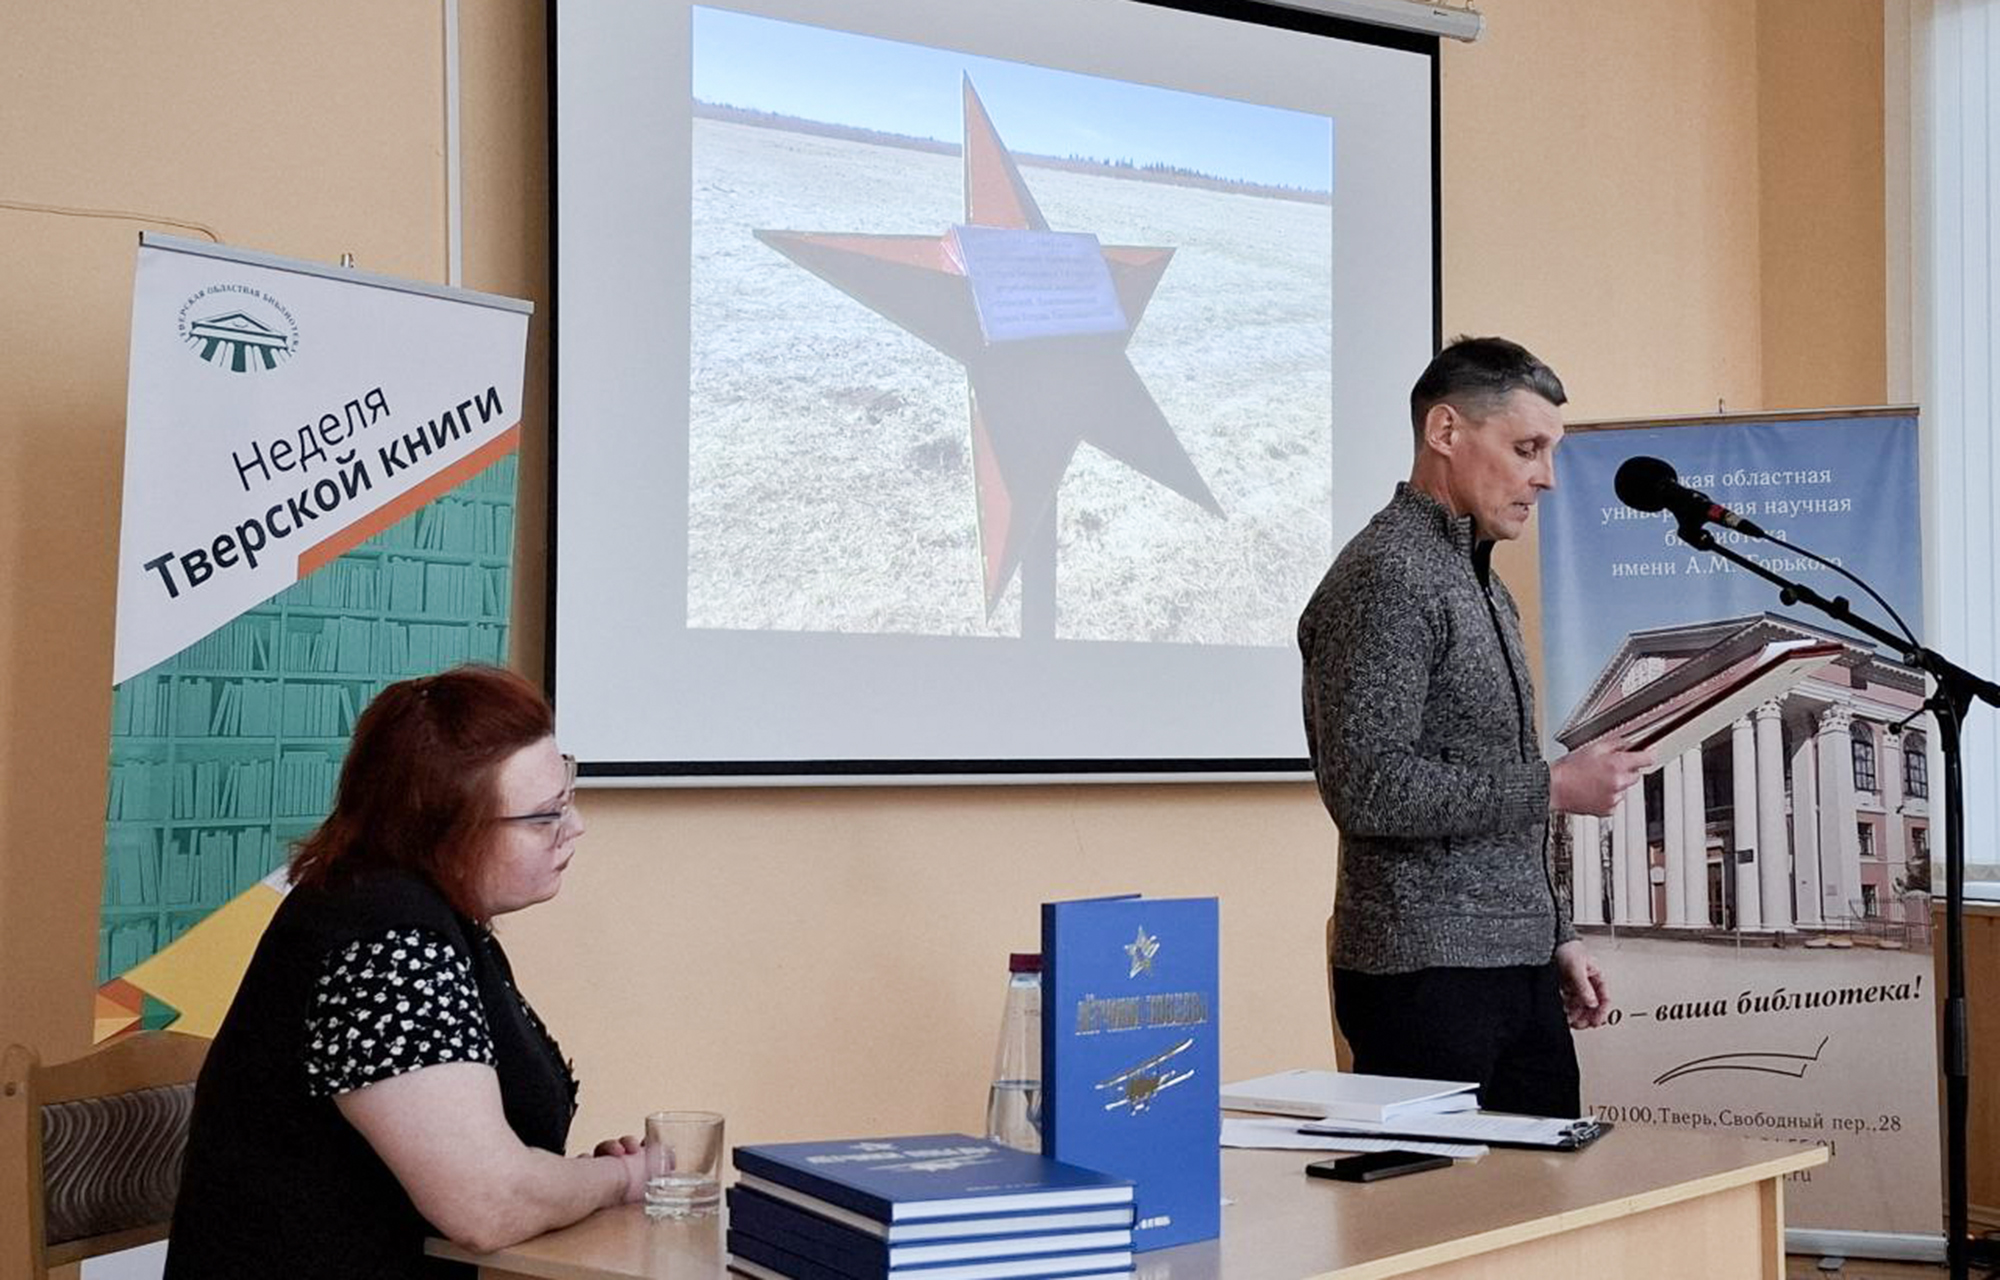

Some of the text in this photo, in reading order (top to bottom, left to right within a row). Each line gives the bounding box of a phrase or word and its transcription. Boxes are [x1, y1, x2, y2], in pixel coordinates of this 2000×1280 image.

[232, 387, 390, 491] Неделя
[144, 386, 504, 599] Тверской книги
[1722, 469, 1832, 487] областная
[1765, 498, 1852, 518] научная
[1612, 561, 1676, 577] имени
[1655, 1001, 1727, 1022] ваша
[1737, 975, 1923, 1015] библиотека!
